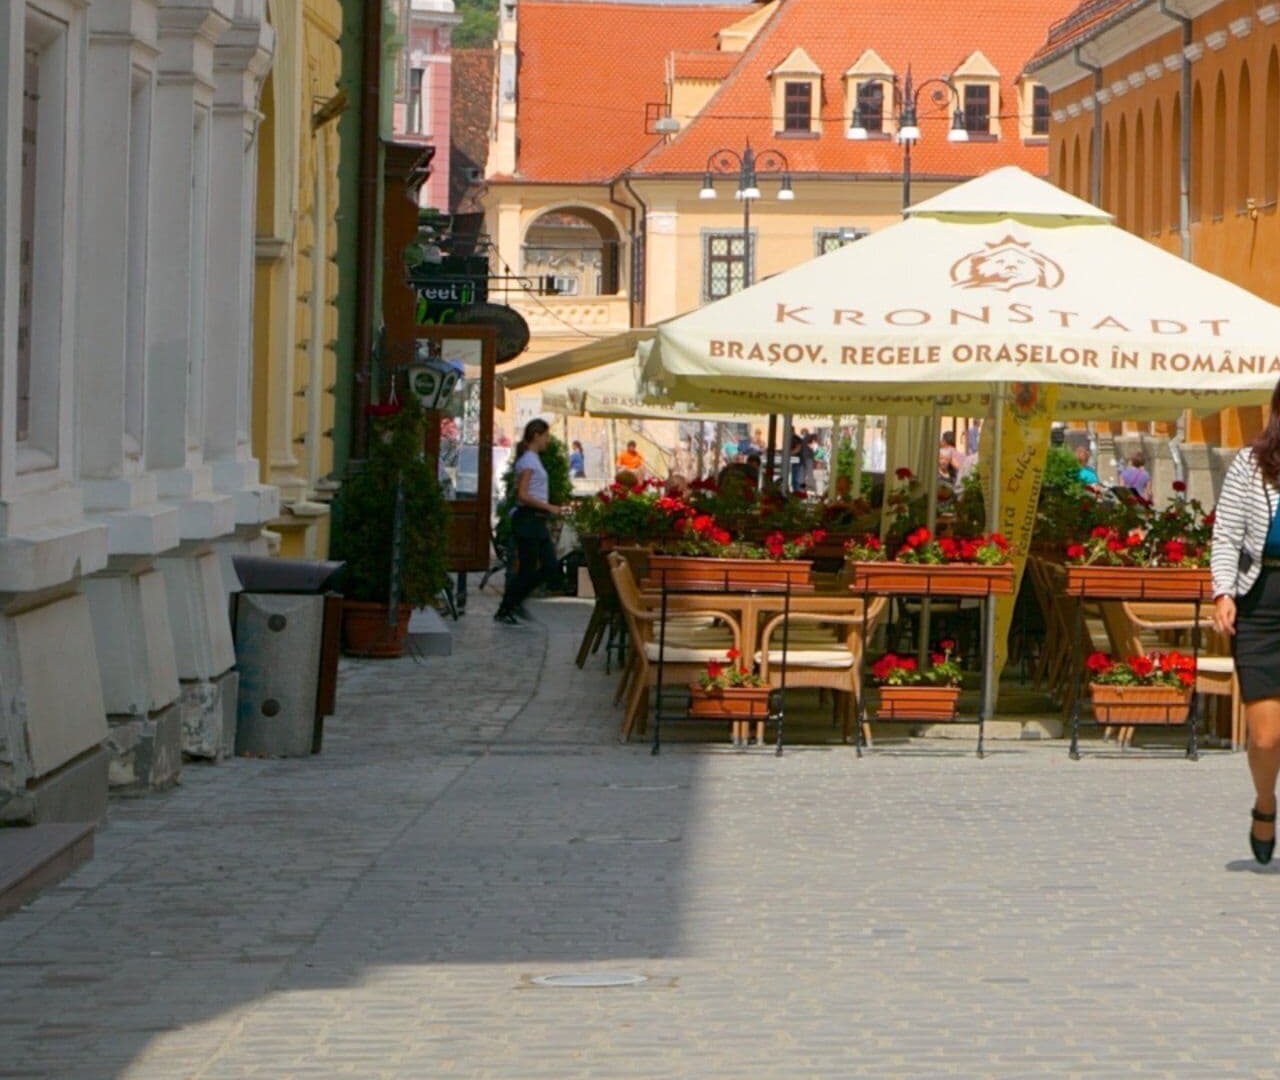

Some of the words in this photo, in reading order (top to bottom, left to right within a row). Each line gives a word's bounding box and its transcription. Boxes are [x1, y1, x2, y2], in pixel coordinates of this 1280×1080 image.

[775, 302, 1230, 337] KRONSTADT
[709, 339, 828, 365] BRAȘOV.
[840, 345, 941, 366] REGELE
[951, 343, 1098, 369] ORAȘELOR
[1111, 345, 1140, 370] ÎN
